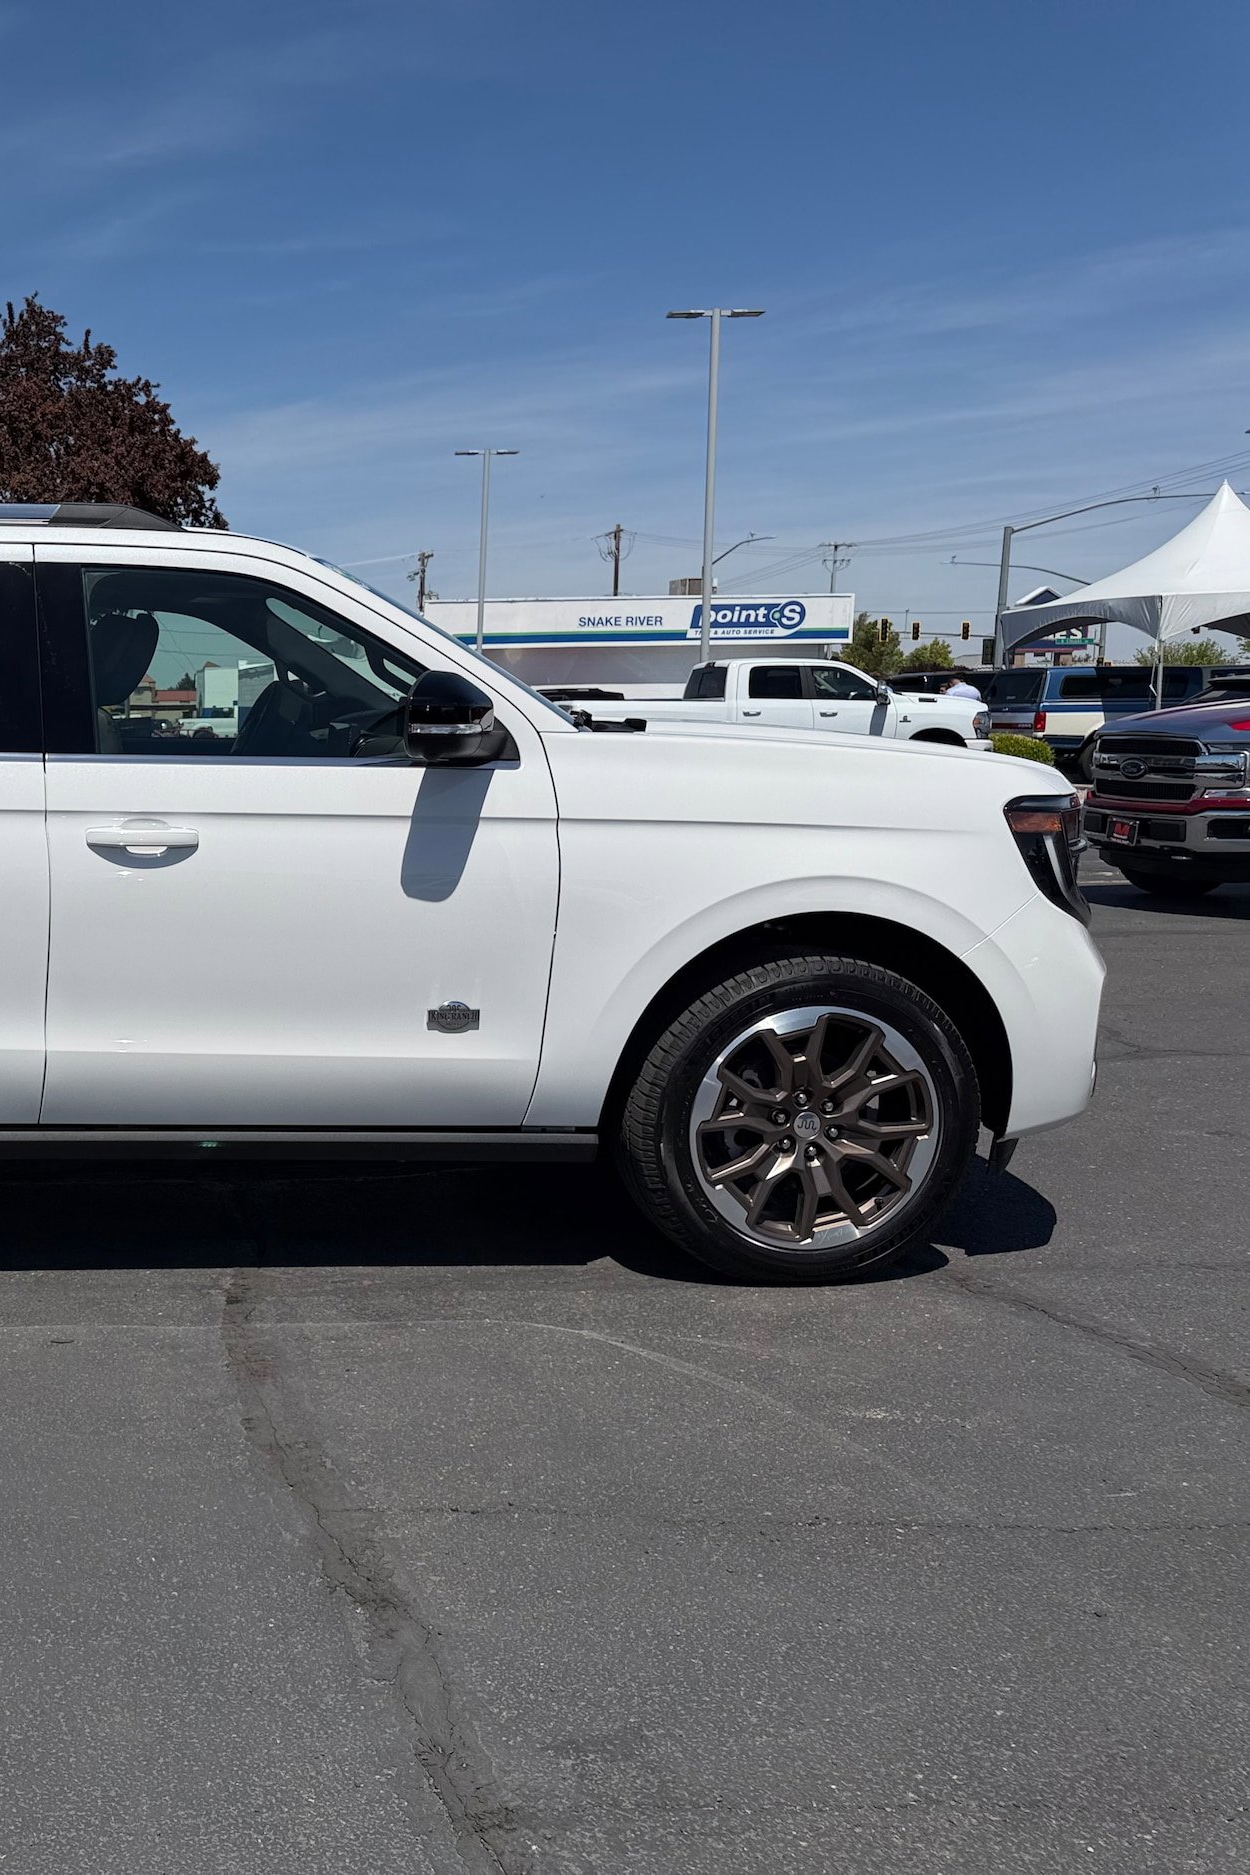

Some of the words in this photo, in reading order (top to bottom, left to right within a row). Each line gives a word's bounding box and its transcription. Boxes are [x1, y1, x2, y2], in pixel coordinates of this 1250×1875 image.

[578, 616, 622, 628] SNAKE
[625, 616, 663, 627] RIVER
[743, 628, 775, 636] SERVICE
[430, 1011, 450, 1022] KING
[451, 1011, 477, 1021] RANCH
